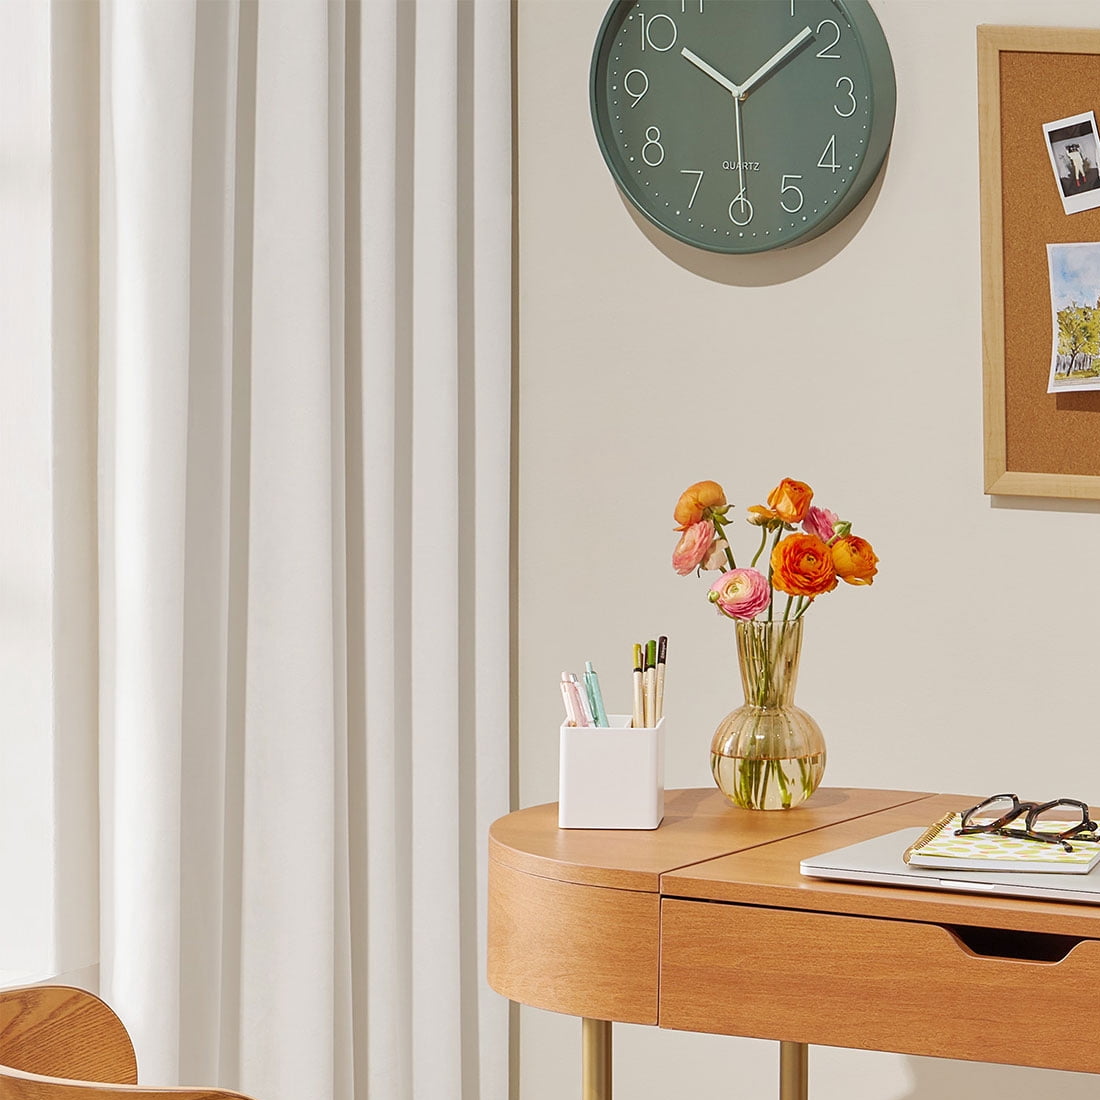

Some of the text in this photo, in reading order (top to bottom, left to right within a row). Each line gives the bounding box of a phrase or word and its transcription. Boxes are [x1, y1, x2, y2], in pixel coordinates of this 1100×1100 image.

[639, 13, 677, 52] 10
[815, 19, 841, 58] 2
[624, 69, 649, 108] 9
[834, 76, 856, 117] 3
[642, 126, 665, 166] 8
[722, 160, 760, 171] QUARTZ
[817, 134, 841, 173] 4
[680, 169, 704, 209] 7
[728, 187, 754, 225] 6
[780, 174, 804, 213] 5
